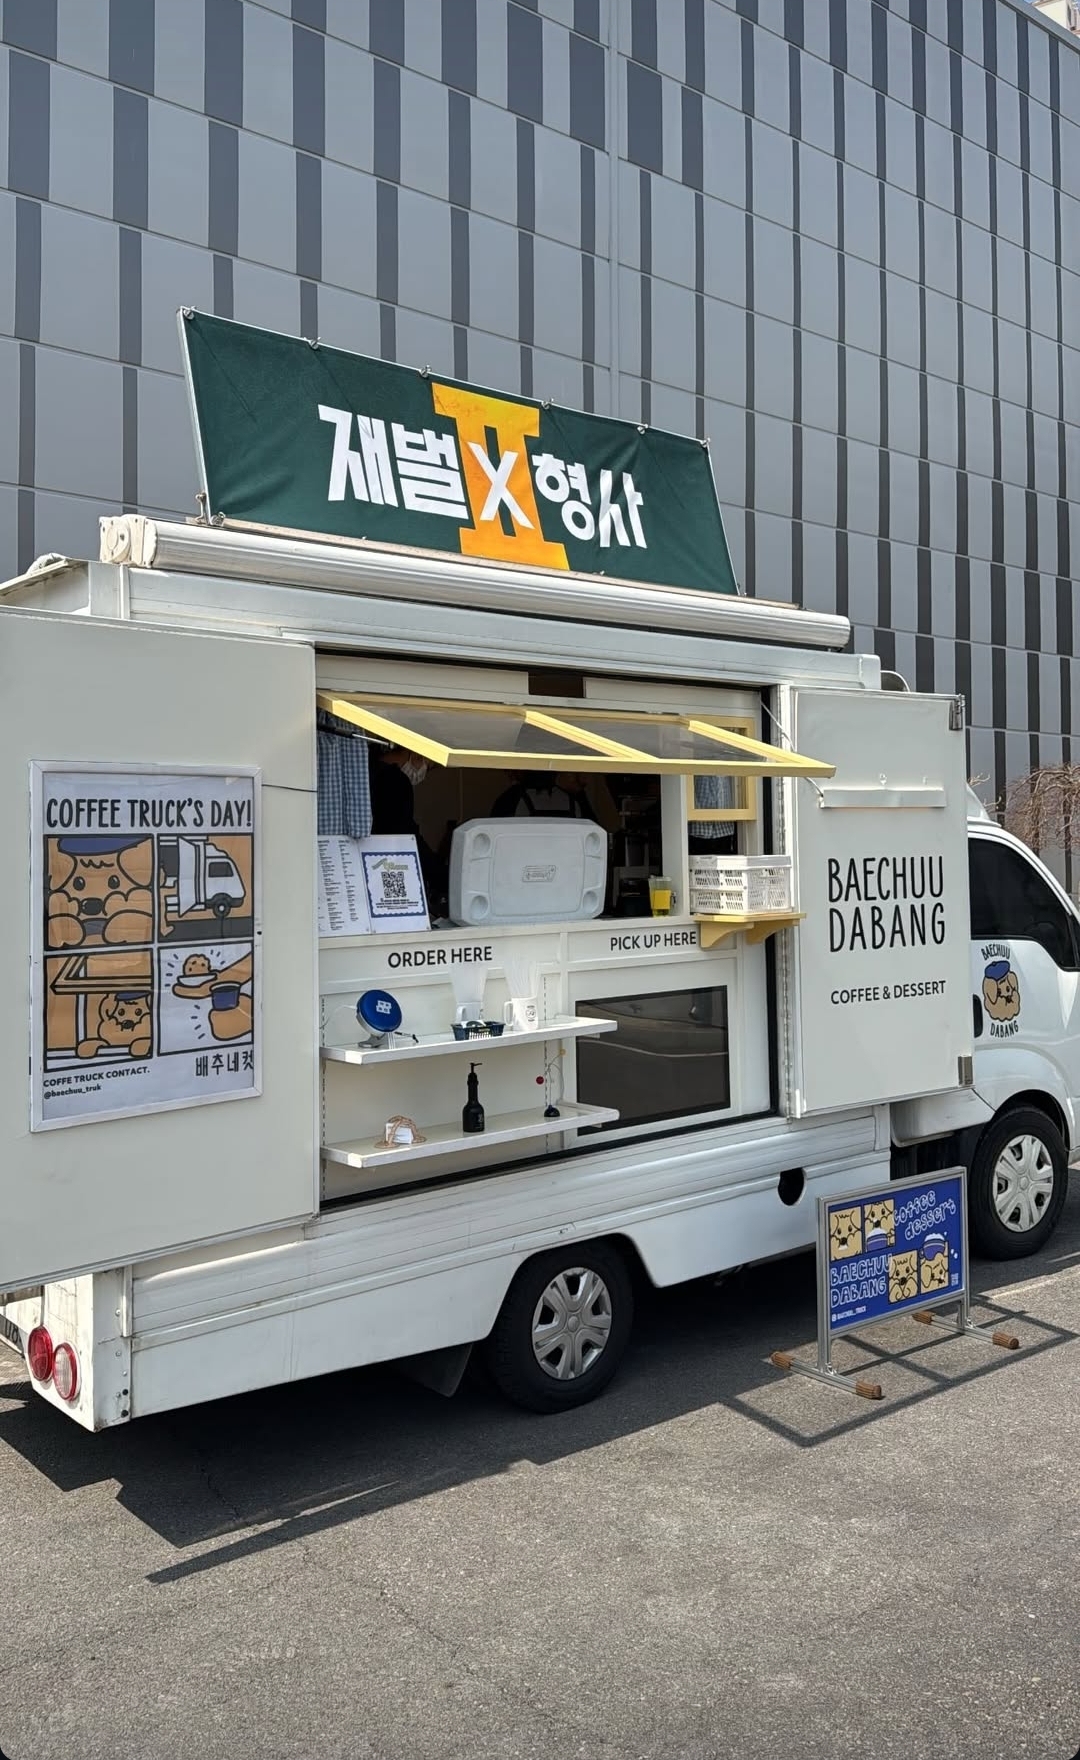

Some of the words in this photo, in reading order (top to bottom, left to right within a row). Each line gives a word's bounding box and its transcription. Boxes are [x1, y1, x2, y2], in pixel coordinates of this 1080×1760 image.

[46, 798, 121, 828] COFFEE
[127, 797, 204, 828] TRUCK'S
[210, 799, 252, 828] DAY!
[828, 856, 943, 902] BAECHUU
[830, 902, 945, 952] DABANG
[610, 935, 641, 951] PICK
[643, 934, 661, 948] UP
[664, 931, 697, 947] HERE
[981, 943, 1011, 961] BAECHUU
[387, 949, 447, 968] ORDER
[451, 946, 493, 963] HERE
[830, 987, 880, 1004] COFFEE
[882, 985, 891, 1000] &
[893, 980, 946, 999] DESSERT
[990, 1020, 1019, 1038] DABANG
[43, 1076, 72, 1087] COFFE
[74, 1072, 104, 1083] TRUCK
[105, 1066, 150, 1079] CONTACT.
[904, 1198, 956, 1241] dessert
[830, 1253, 893, 1287] BAECHUU
[831, 1276, 887, 1308] DABANG
